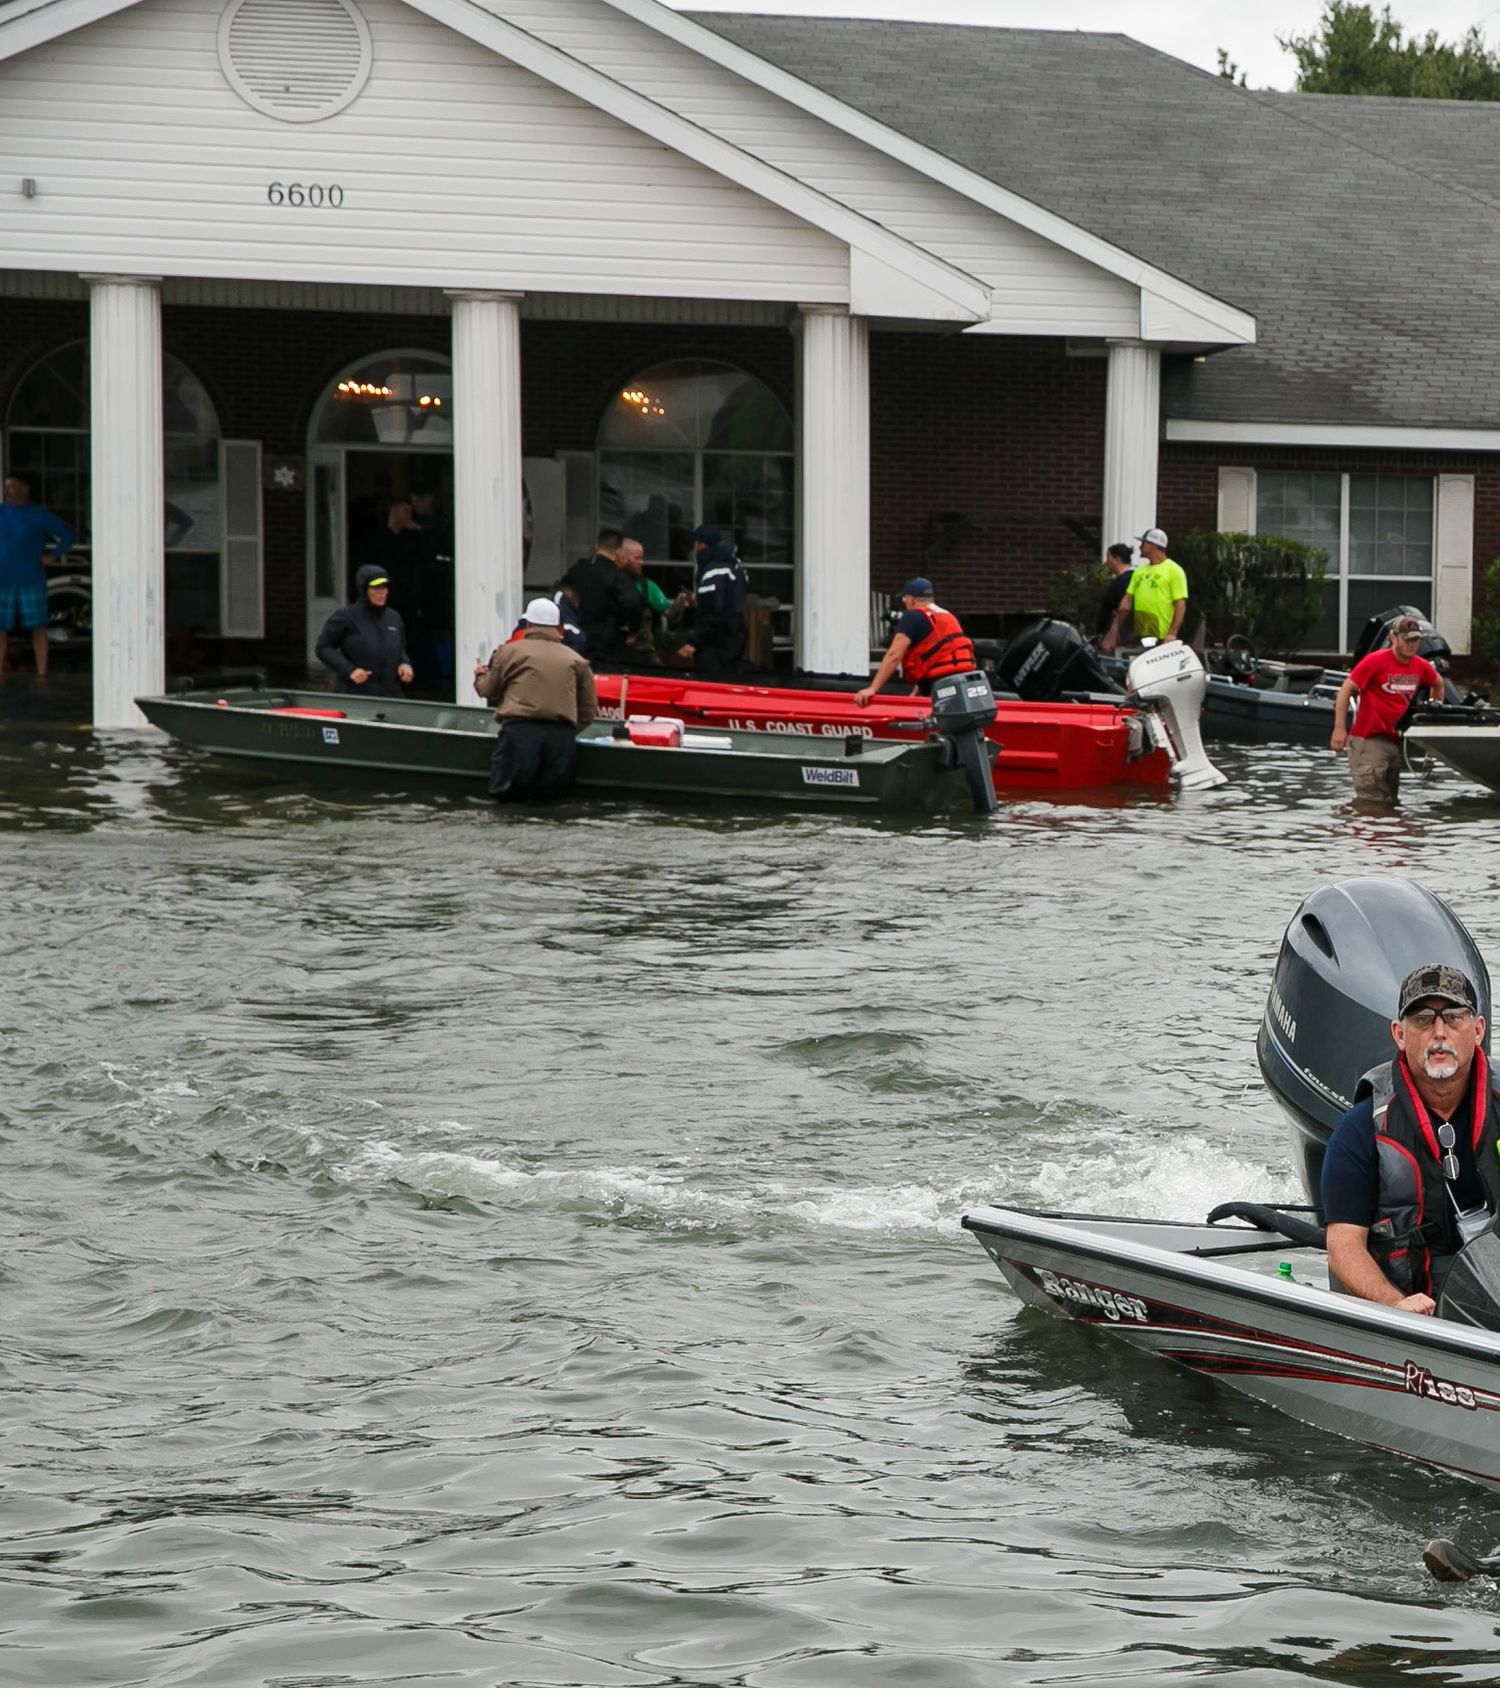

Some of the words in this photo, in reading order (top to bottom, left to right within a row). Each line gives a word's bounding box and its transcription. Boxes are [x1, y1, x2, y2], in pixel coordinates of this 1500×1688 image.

[267, 182, 343, 208] 6600
[1146, 650, 1185, 664] HONDA
[966, 685, 988, 698] 25
[766, 721, 814, 736] COAST
[822, 724, 873, 738] GUARD
[1033, 1266, 1149, 1322] Ranger
